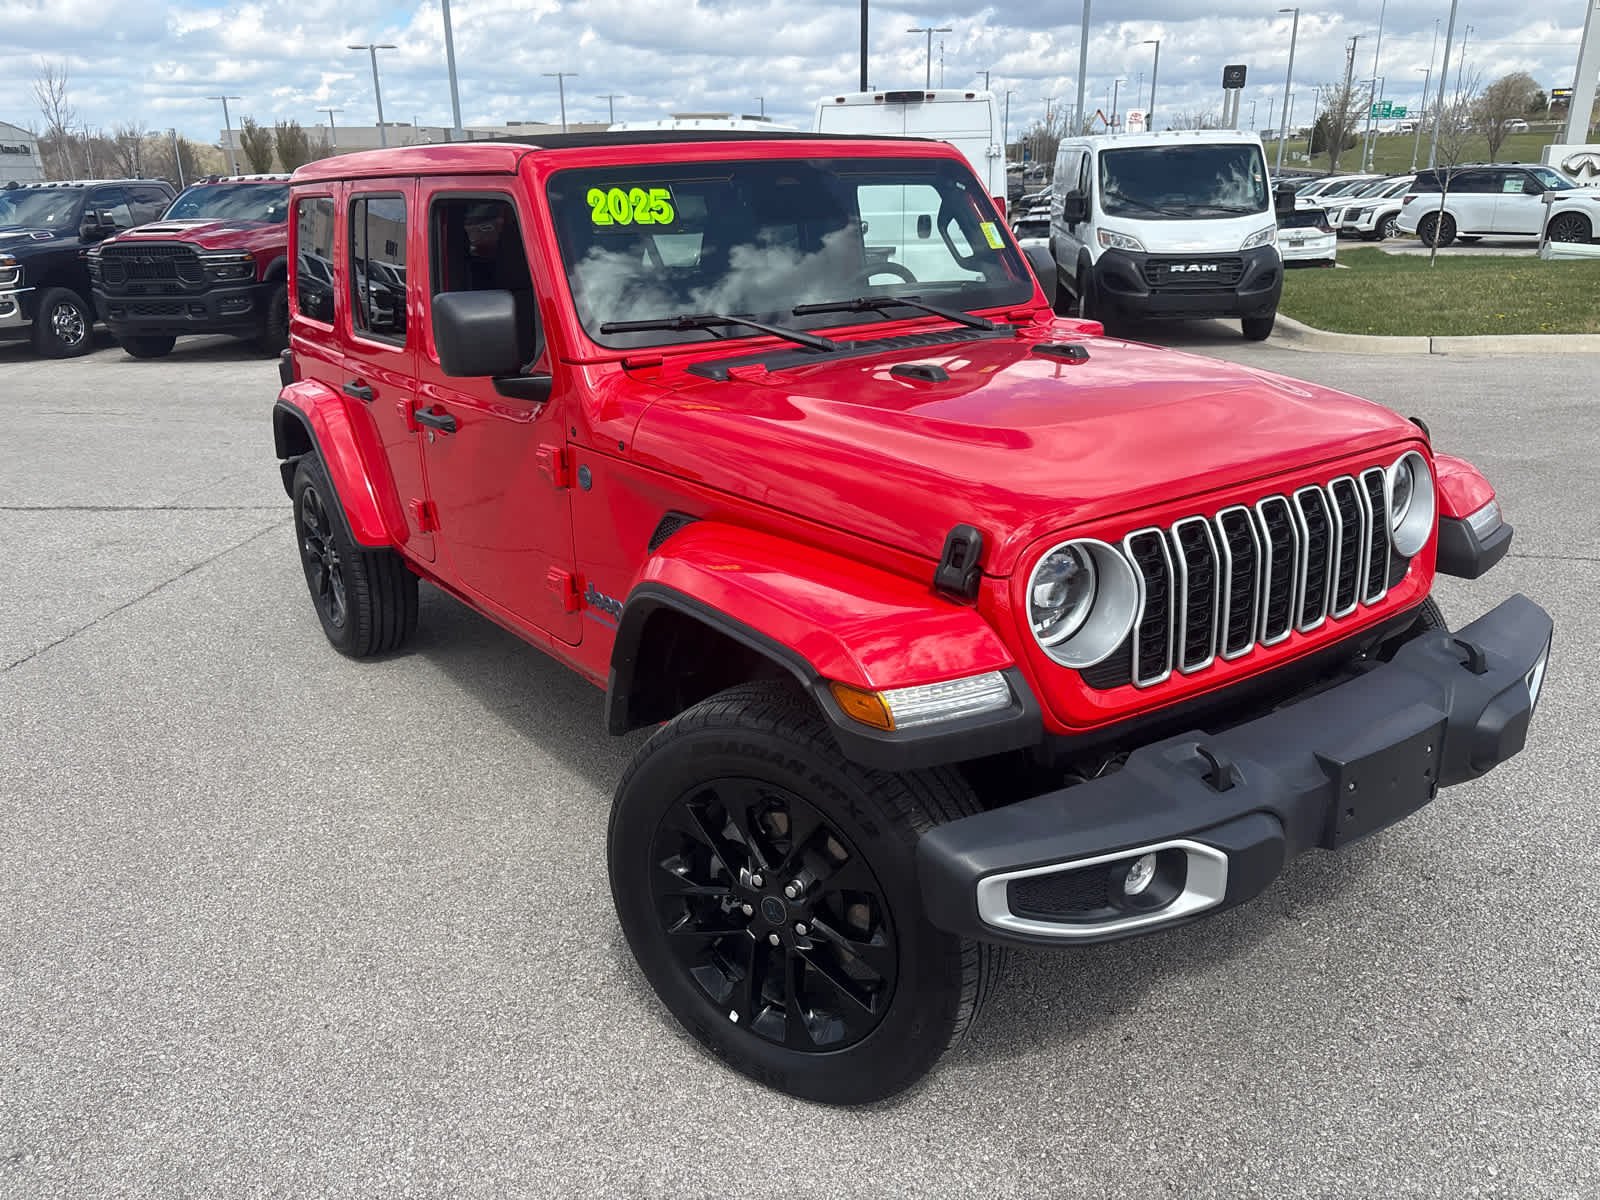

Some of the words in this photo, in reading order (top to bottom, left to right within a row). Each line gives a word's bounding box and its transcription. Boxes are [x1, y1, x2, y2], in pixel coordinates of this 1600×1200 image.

[587, 187, 675, 226] 2025
[1170, 264, 1218, 273] RAM
[584, 582, 624, 622] Jeep
